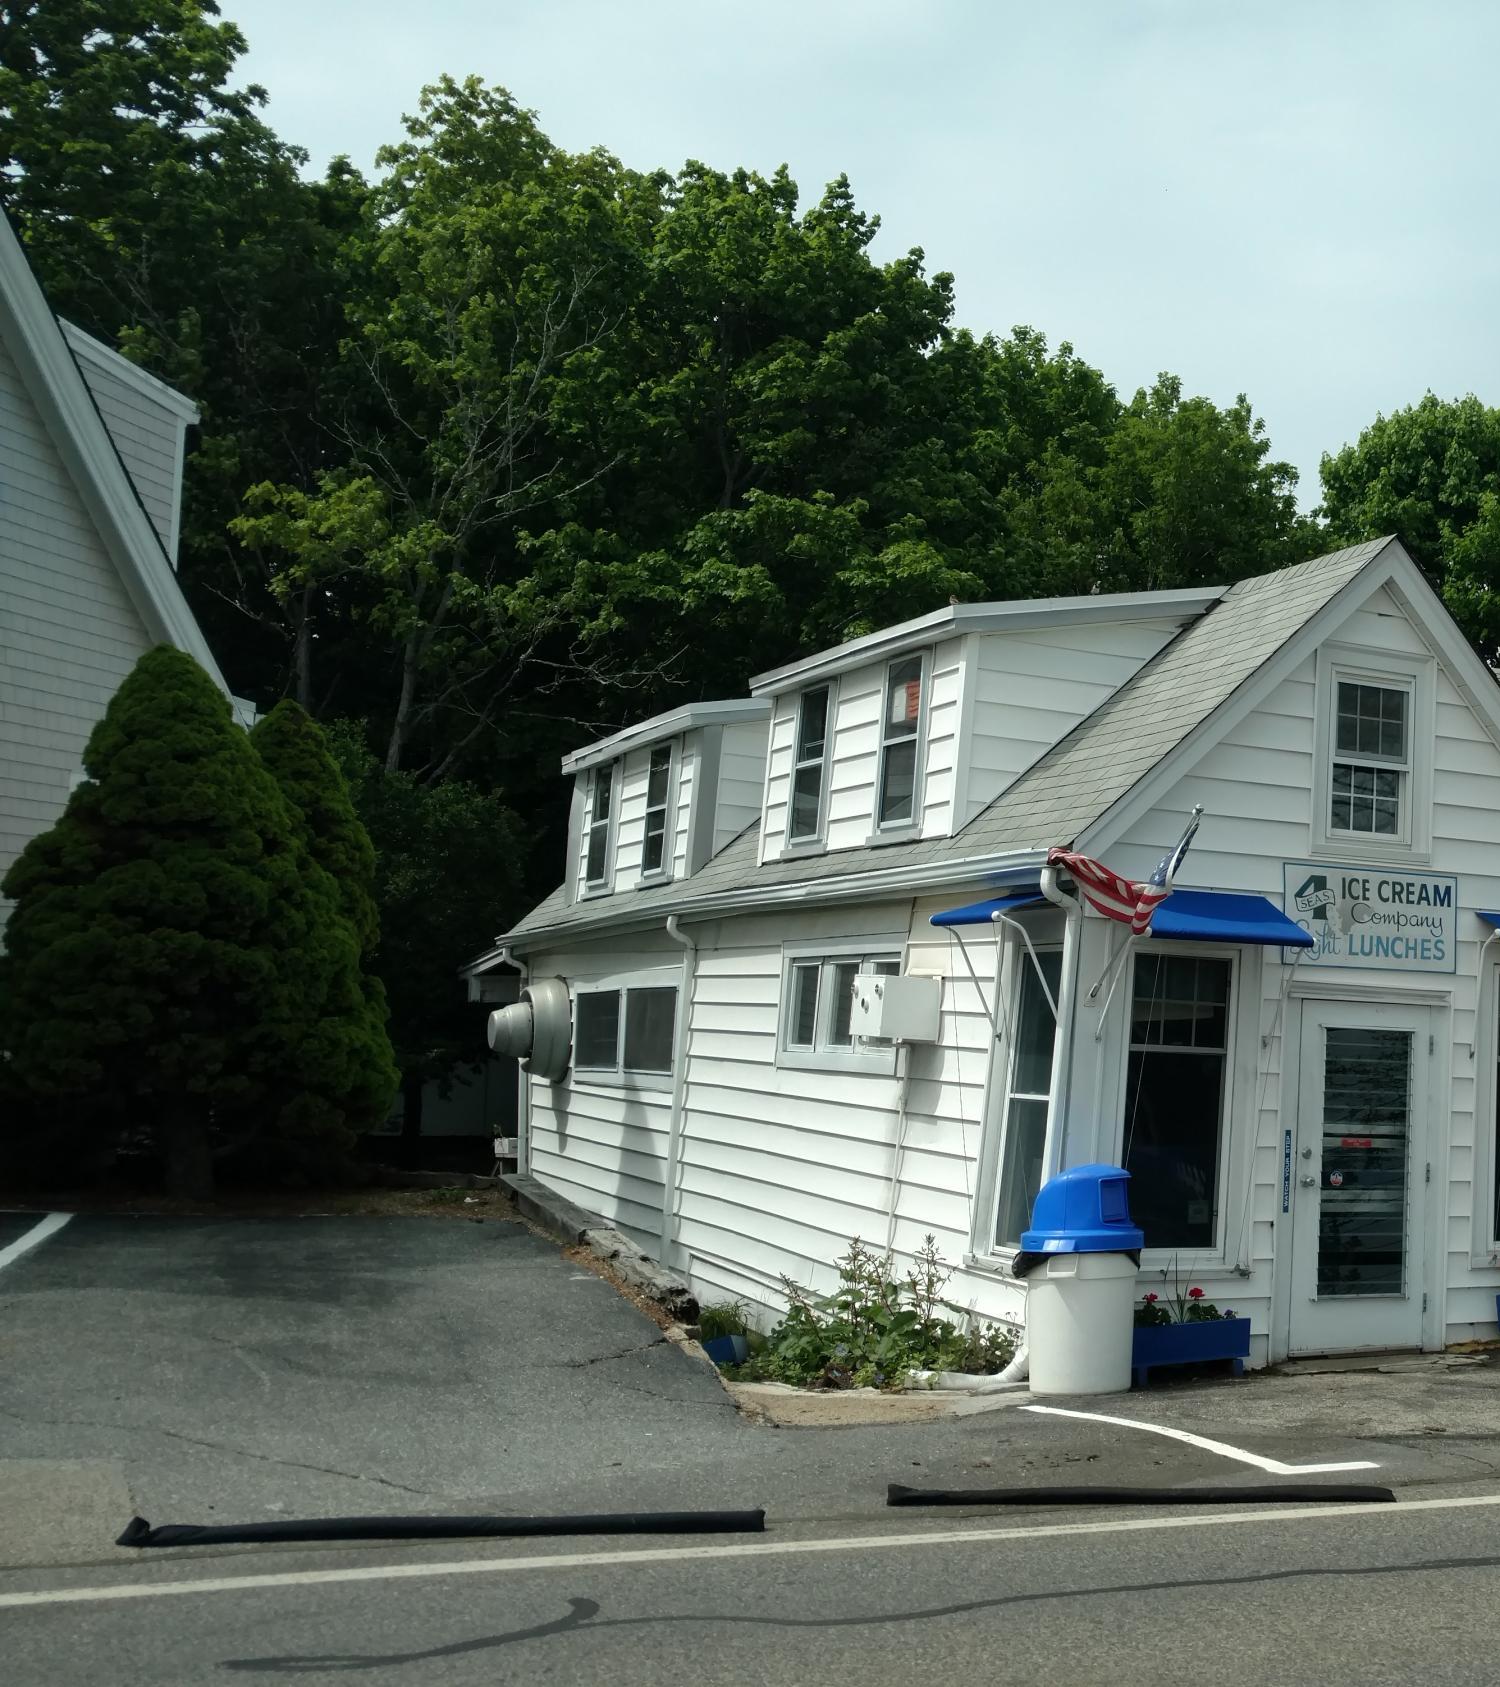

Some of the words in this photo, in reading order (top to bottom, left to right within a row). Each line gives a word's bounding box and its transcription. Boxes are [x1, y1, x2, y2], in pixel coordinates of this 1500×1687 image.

[1294, 875, 1328, 921] 4
[1301, 891, 1330, 909] SEAS
[1341, 877, 1370, 901] ICE
[1377, 880, 1452, 908] CREAM
[1351, 902, 1443, 938] Company
[1348, 934, 1446, 961] LUNCHES
